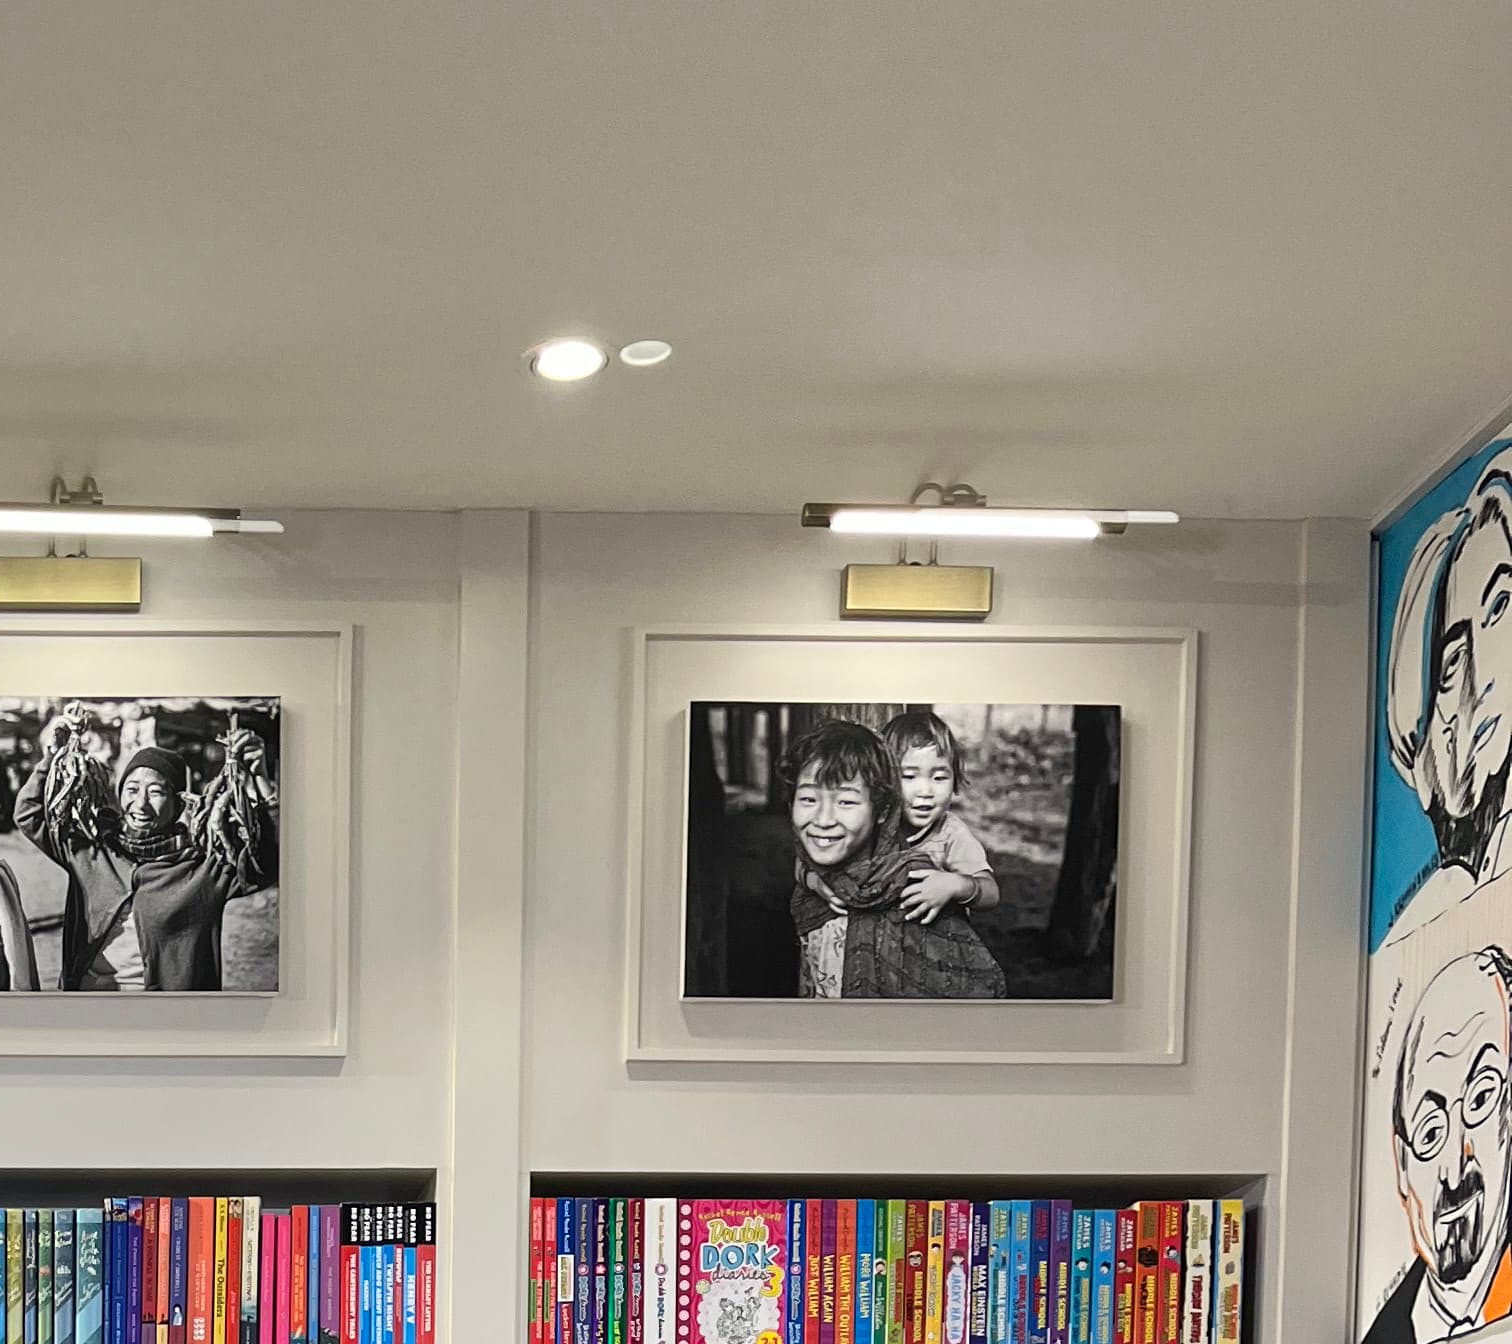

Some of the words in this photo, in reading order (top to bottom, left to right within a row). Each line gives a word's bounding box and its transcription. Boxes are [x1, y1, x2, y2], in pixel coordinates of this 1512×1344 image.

[701, 1243, 778, 1271] DORK
[759, 1265, 785, 1298] 3
[823, 1294, 835, 1323] AGAIN
